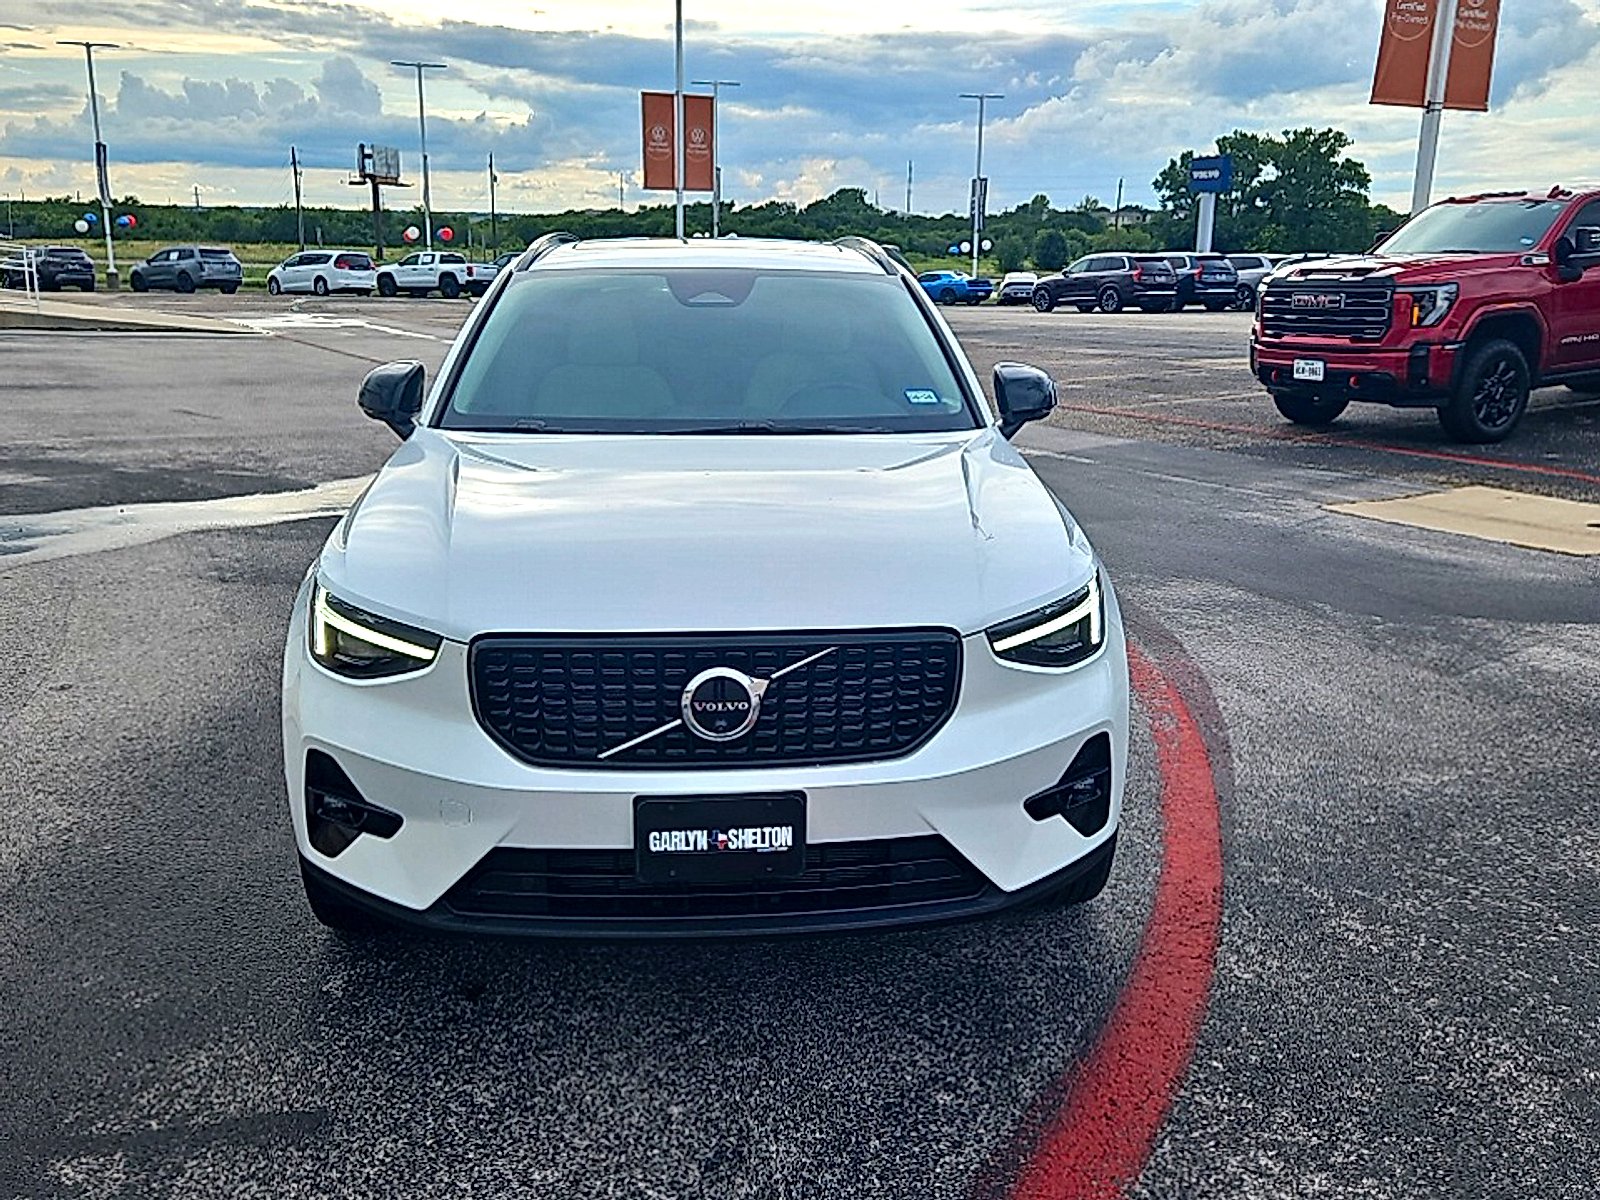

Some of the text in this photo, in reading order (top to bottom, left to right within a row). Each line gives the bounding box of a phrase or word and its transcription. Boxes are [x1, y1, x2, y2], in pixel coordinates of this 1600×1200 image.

[1396, 0, 1427, 12] Certified
[1191, 169, 1220, 180] VOLVO
[1293, 293, 1341, 310] GMC
[693, 701, 749, 712] VOLVO
[648, 825, 793, 853] GARLYN SHELTON
